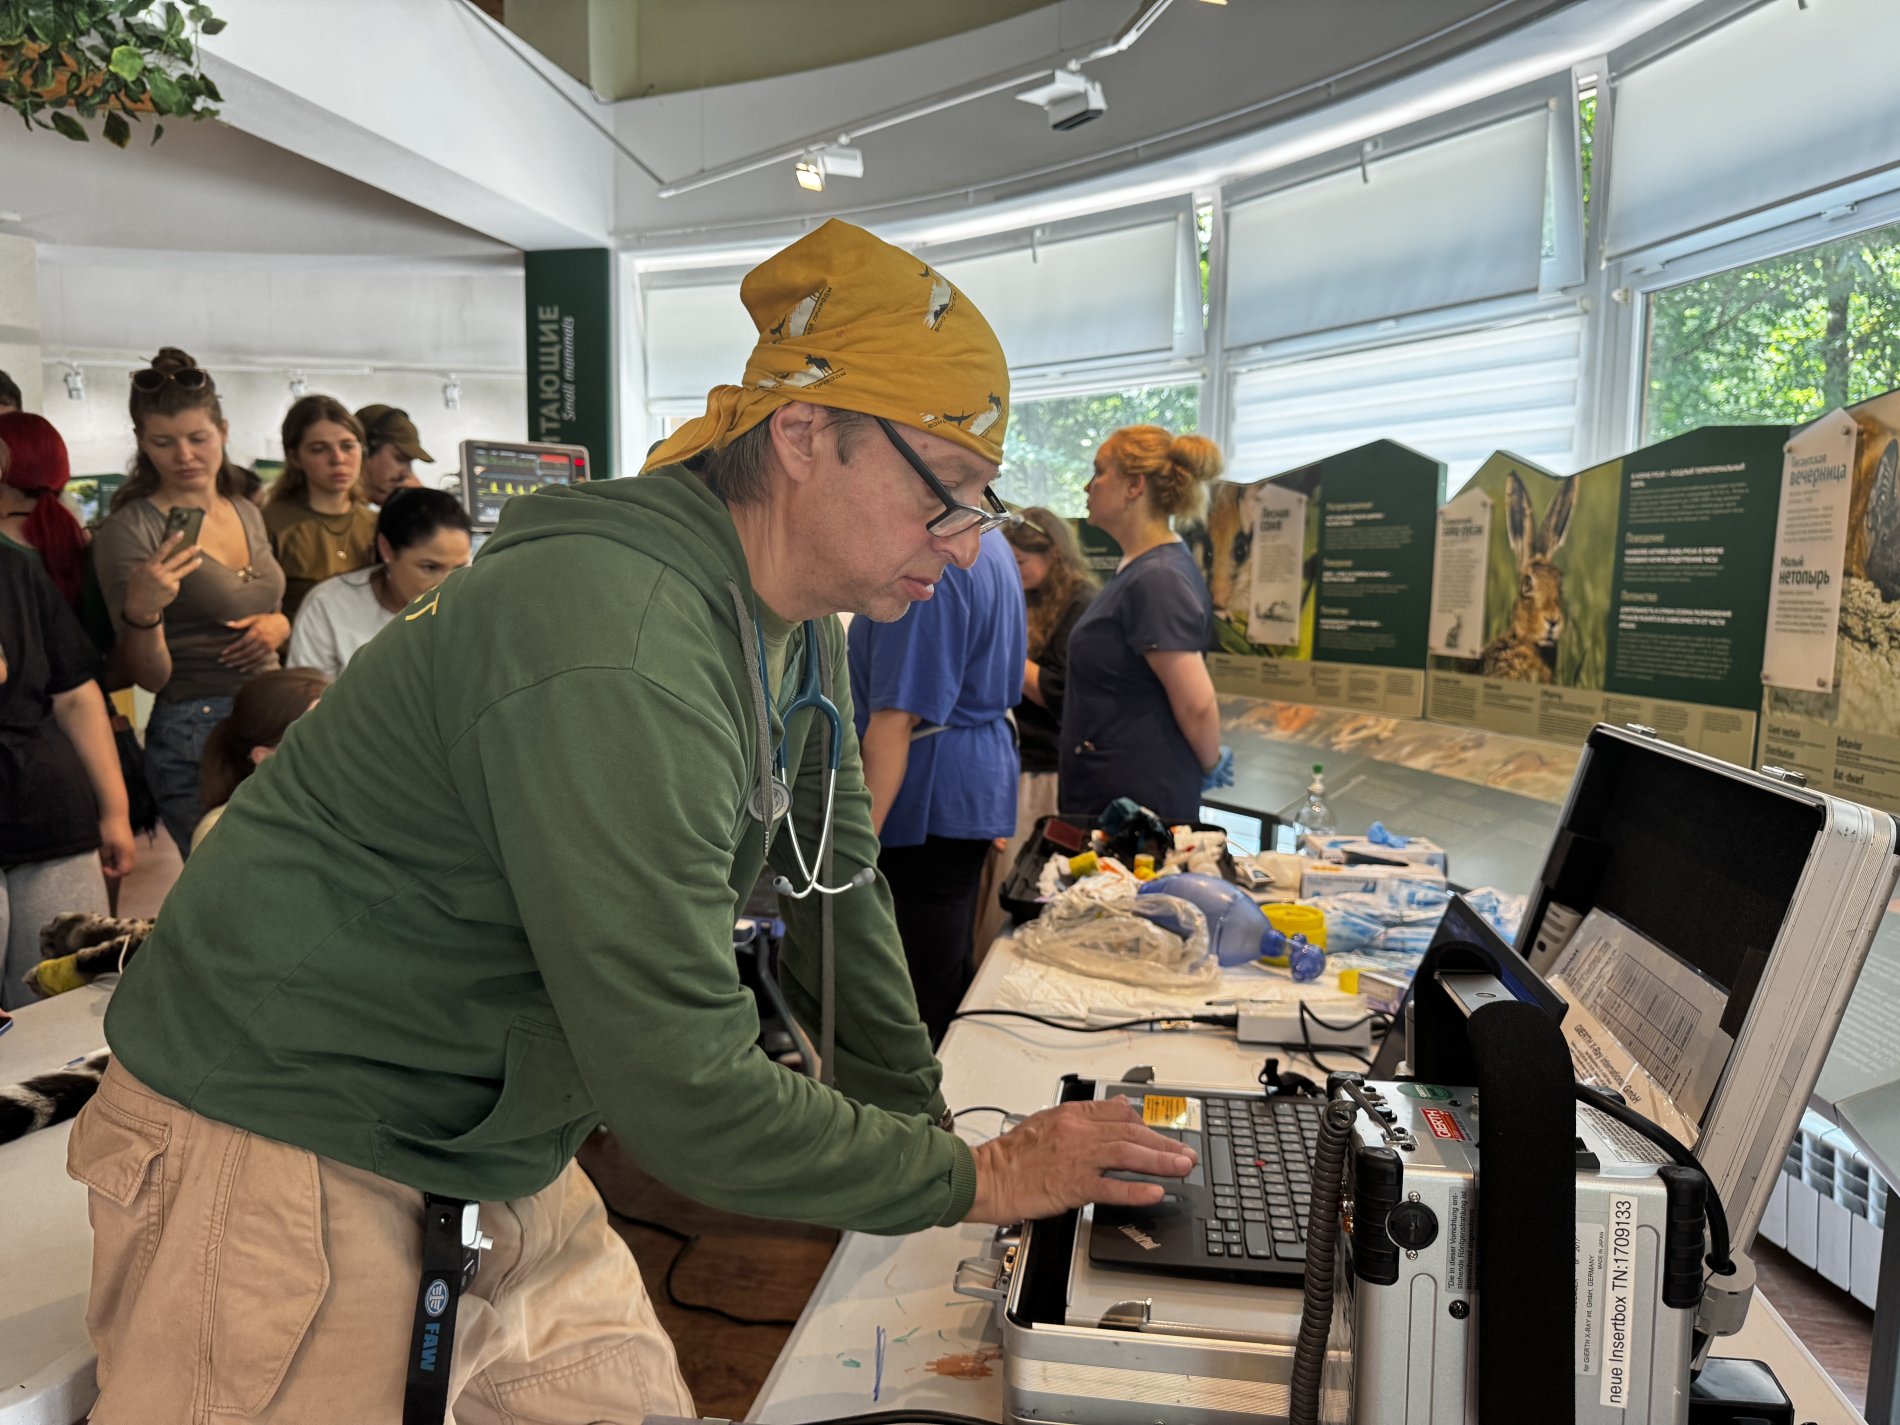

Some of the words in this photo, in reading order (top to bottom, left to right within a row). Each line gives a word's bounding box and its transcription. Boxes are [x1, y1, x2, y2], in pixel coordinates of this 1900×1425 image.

[561, 315, 576, 382] mammals
[562, 382, 576, 422] Small
[1789, 463, 1847, 487] вечерница
[1778, 569, 1831, 590] нетопырь
[1780, 555, 1804, 568] Малый
[1574, 1024, 1593, 1046] GIERTH
[1622, 1085, 1642, 1104] GmbH
[1424, 1109, 1452, 1138] GIERTH
[1450, 1207, 1459, 1245] Vorrichtung
[1458, 1199, 1468, 1258] Röntgenstrahlung
[1611, 1200, 1632, 1292] TN:1709133
[420, 1322, 441, 1372] FAW
[1608, 1296, 1627, 1364] Insertbox
[1610, 1368, 1623, 1404] neue
